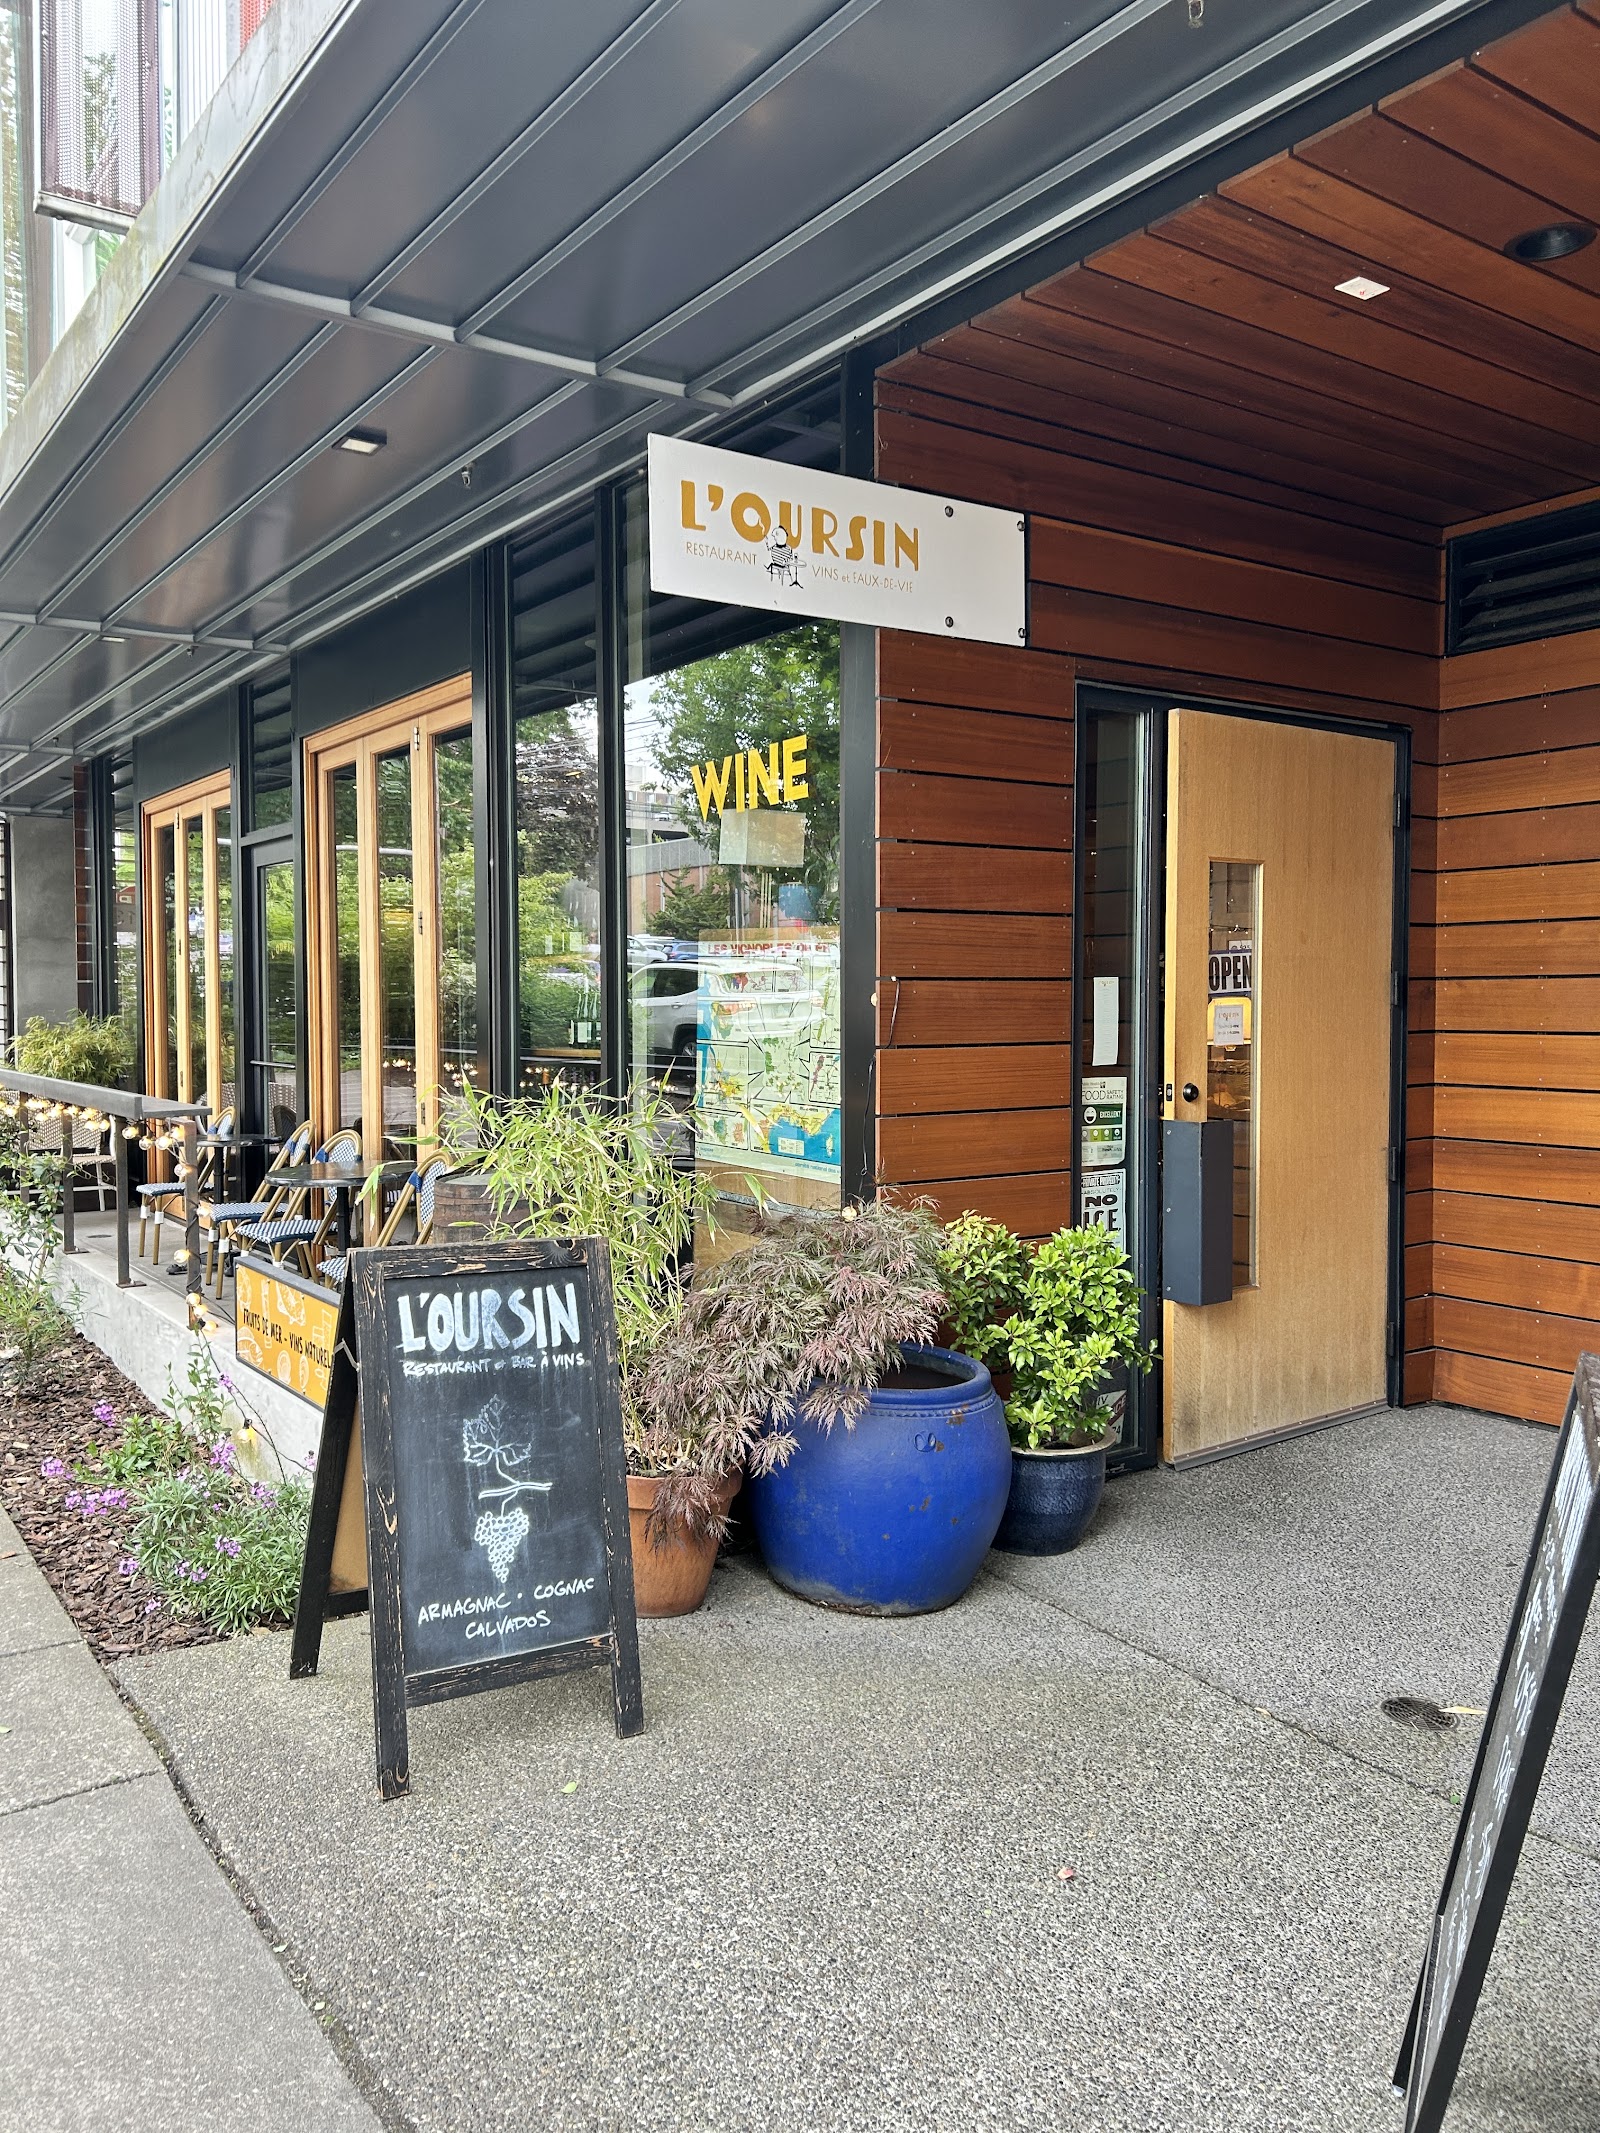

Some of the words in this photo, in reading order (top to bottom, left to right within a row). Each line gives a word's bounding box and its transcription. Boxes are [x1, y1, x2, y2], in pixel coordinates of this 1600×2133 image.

[681, 480, 919, 571] L'OURSIN
[686, 541, 757, 566] RESTAURANT
[811, 564, 839, 581] VINS
[841, 574, 850, 583] et
[853, 572, 914, 594] EAUX-DE-VIE
[690, 734, 809, 822] WINE
[1208, 955, 1252, 991] OPEN
[1085, 1194, 1118, 1208] NO
[243, 1308, 261, 1333] FRUITS
[262, 1318, 269, 1336] DE
[270, 1325, 283, 1345] MER
[289, 1331, 303, 1355] VINS
[396, 1283, 581, 1353] L'OURSIN
[402, 1358, 492, 1377] RESTAURANT
[511, 1355, 537, 1368] BAR
[552, 1353, 586, 1369] VINS
[418, 1593, 512, 1627] ARMAGNAC
[533, 1577, 595, 1601] COGNAC
[465, 1610, 552, 1640] CALVADOS
